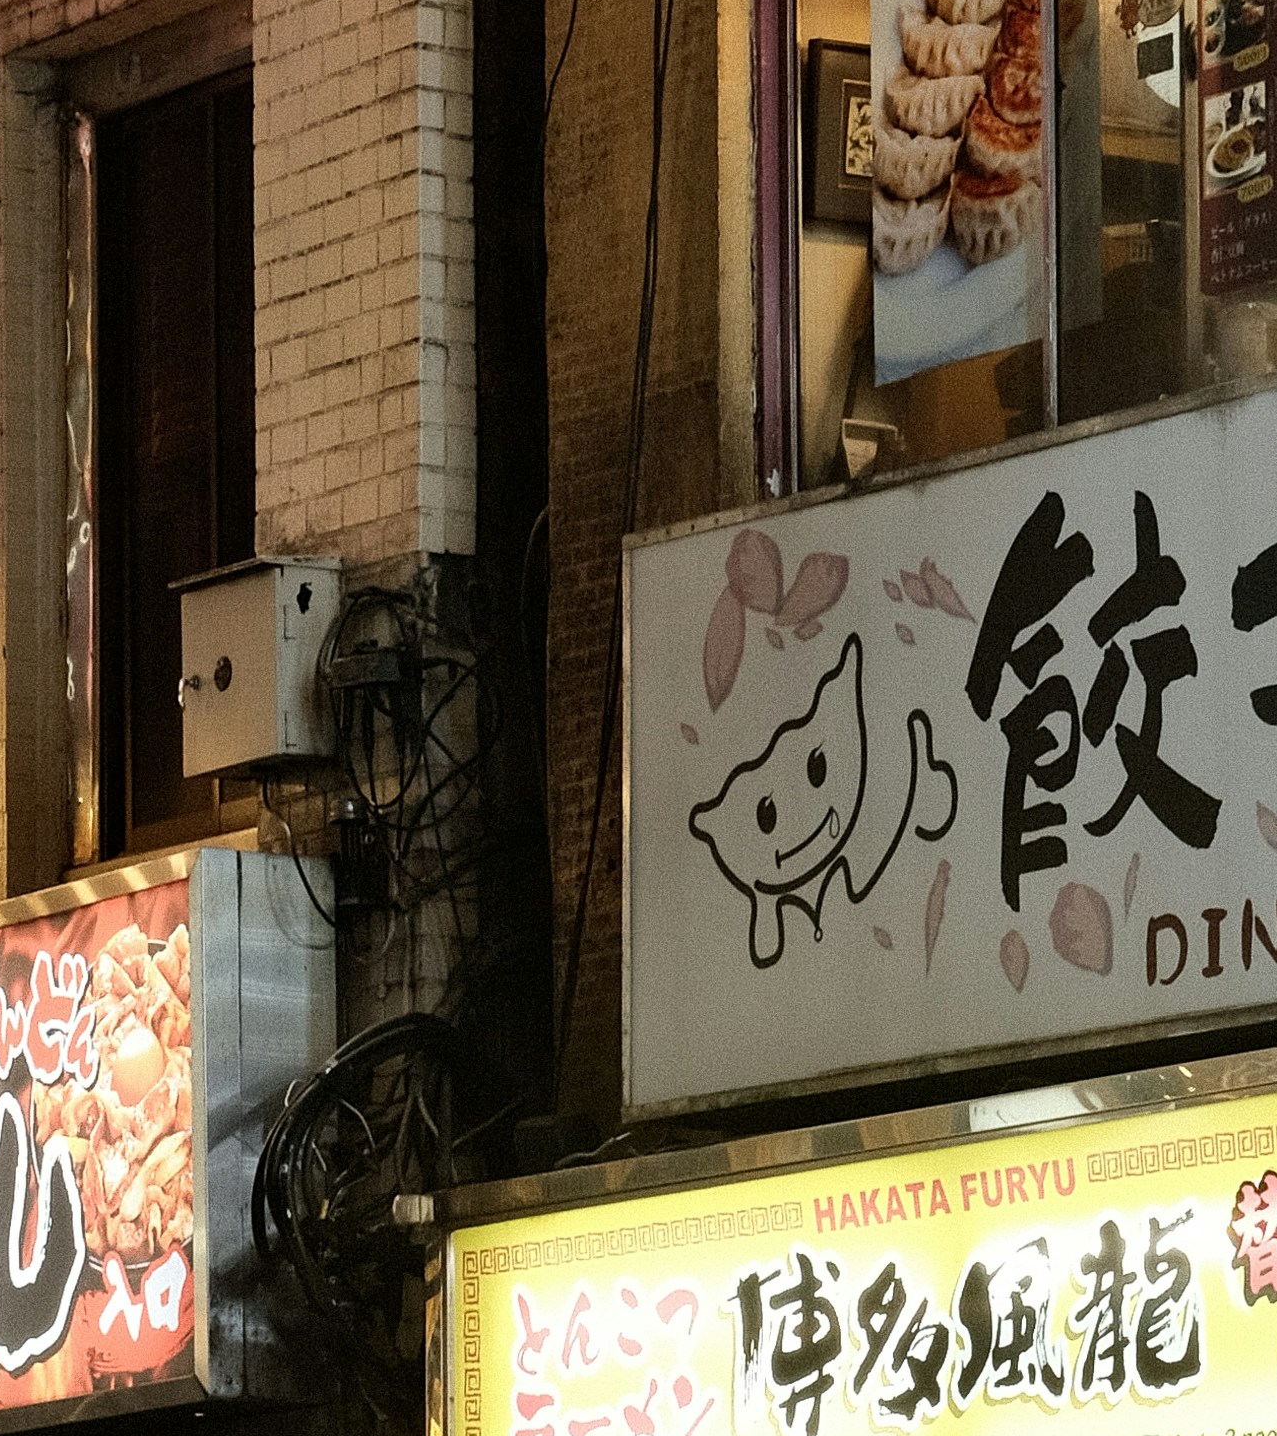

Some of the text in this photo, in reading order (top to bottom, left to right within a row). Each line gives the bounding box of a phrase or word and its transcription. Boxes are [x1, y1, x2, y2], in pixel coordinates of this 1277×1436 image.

[812, 1157, 1078, 1235] HAKATA FURYU
[517, 1286, 701, 1366] とんこつ
